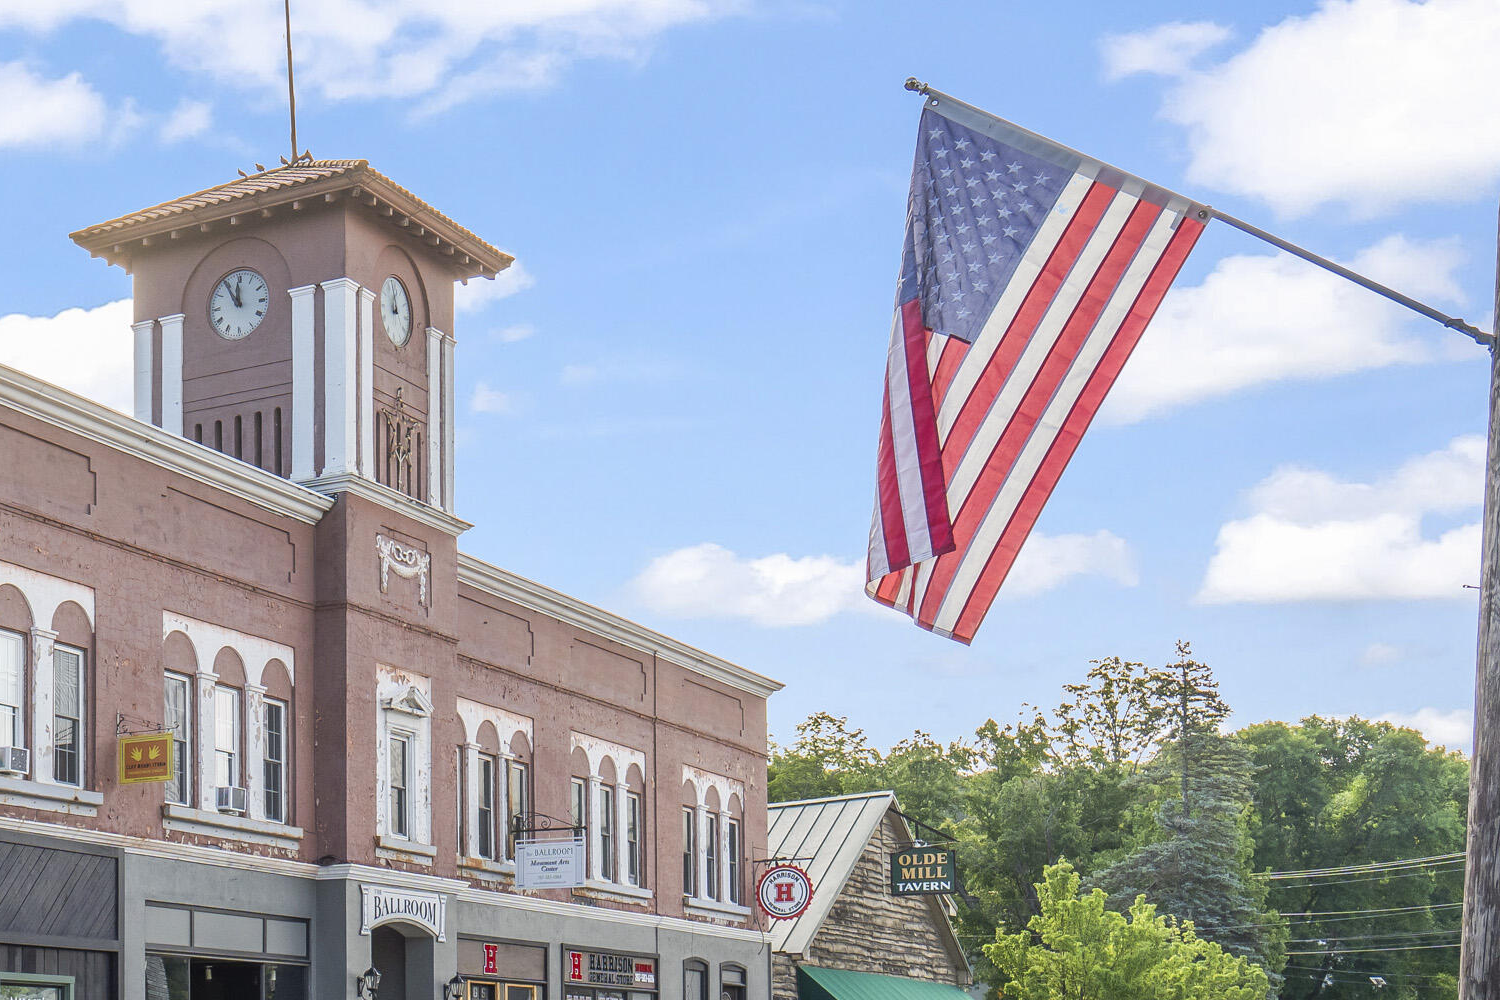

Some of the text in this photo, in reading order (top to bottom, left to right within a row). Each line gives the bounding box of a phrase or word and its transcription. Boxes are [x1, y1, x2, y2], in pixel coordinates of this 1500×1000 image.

[534, 847, 573, 857] BALLROOM
[898, 852, 948, 866] OLDE
[768, 871, 801, 885] HARRISON
[901, 866, 947, 880] MILL
[775, 882, 795, 902] H
[896, 881, 951, 892] TAVERN
[374, 895, 437, 926] BALLROOM
[484, 943, 498, 975] H
[569, 950, 583, 981] H
[588, 953, 634, 974] HARRISON
[589, 972, 616, 985] GENERAL
[616, 974, 634, 985] STORE
